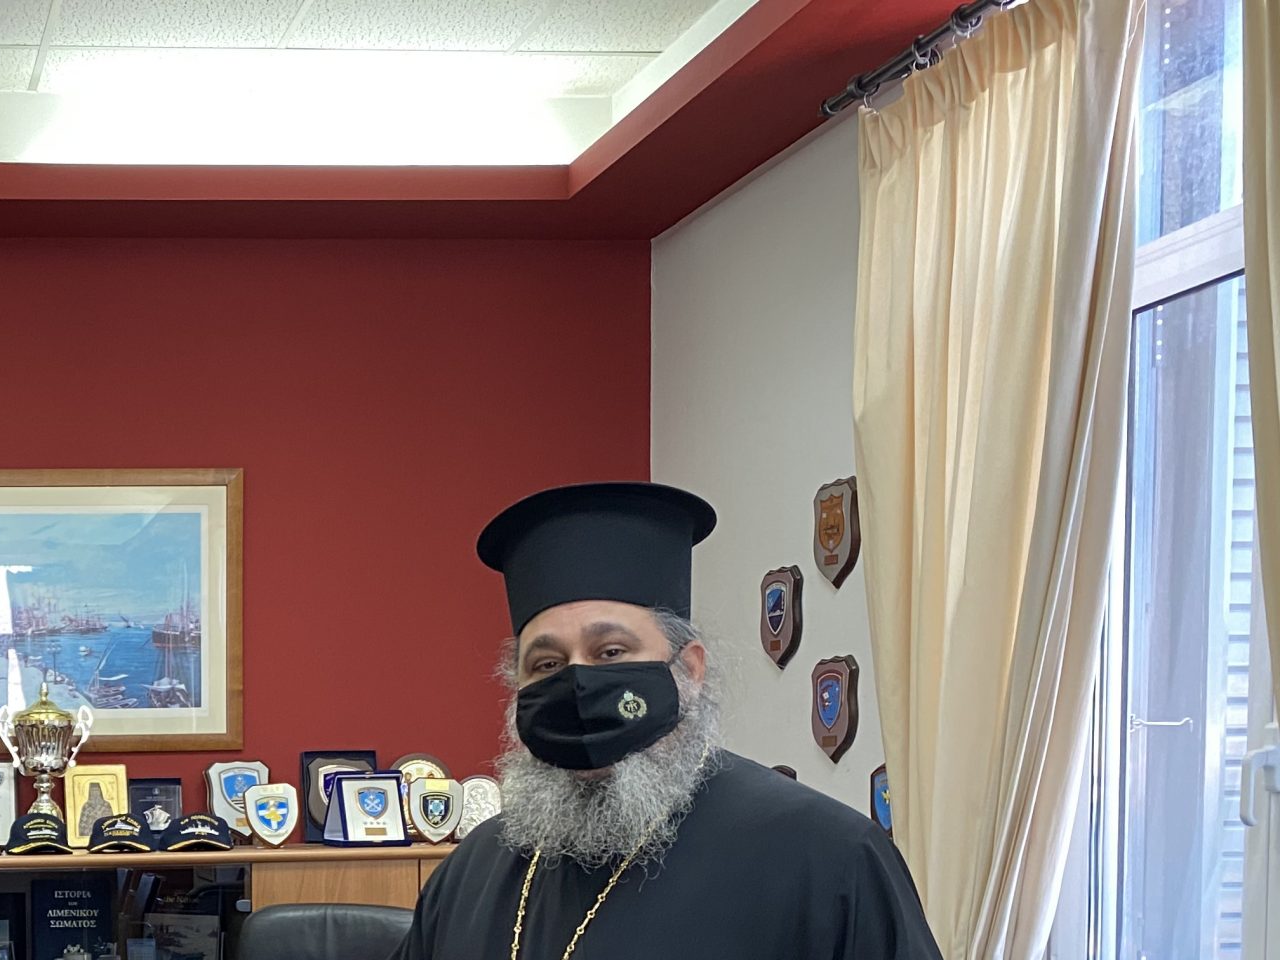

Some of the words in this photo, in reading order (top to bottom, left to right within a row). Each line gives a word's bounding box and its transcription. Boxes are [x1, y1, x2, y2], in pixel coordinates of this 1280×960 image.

[54, 890, 91, 899] ΙΣΤΟΡΙΑ
[46, 909, 99, 918] ΛΙΜΕΝΙΚΟΥ
[49, 919, 97, 928] ΣΩΜΑΤΟΣ
